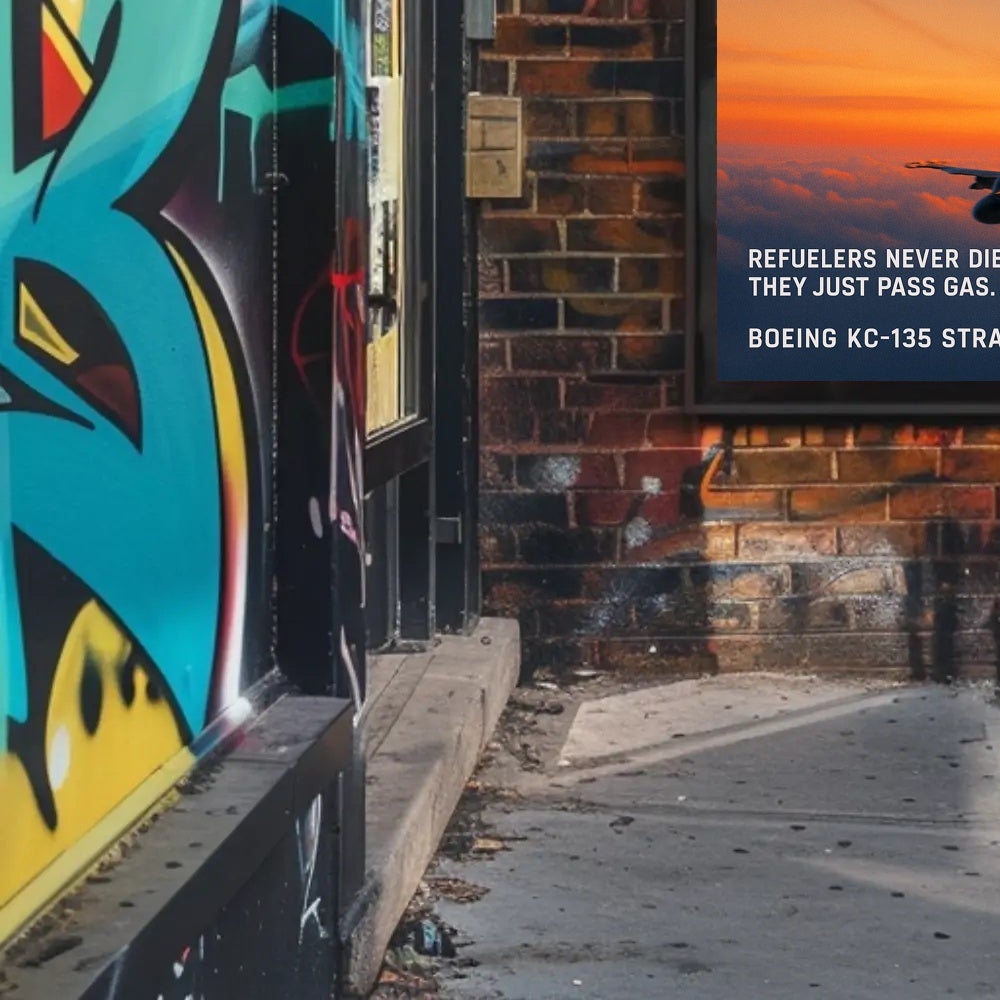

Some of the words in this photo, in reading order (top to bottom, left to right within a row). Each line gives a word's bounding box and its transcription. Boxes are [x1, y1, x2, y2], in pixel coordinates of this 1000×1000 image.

[749, 248, 877, 269] REFUELERS
[887, 248, 959, 269] NEVER
[749, 277, 807, 297] THEY
[813, 277, 870, 297] JUST
[879, 277, 936, 297] PASS
[945, 277, 995, 297] GAS.
[750, 328, 837, 349] BOEING
[849, 328, 932, 349] KC-135
